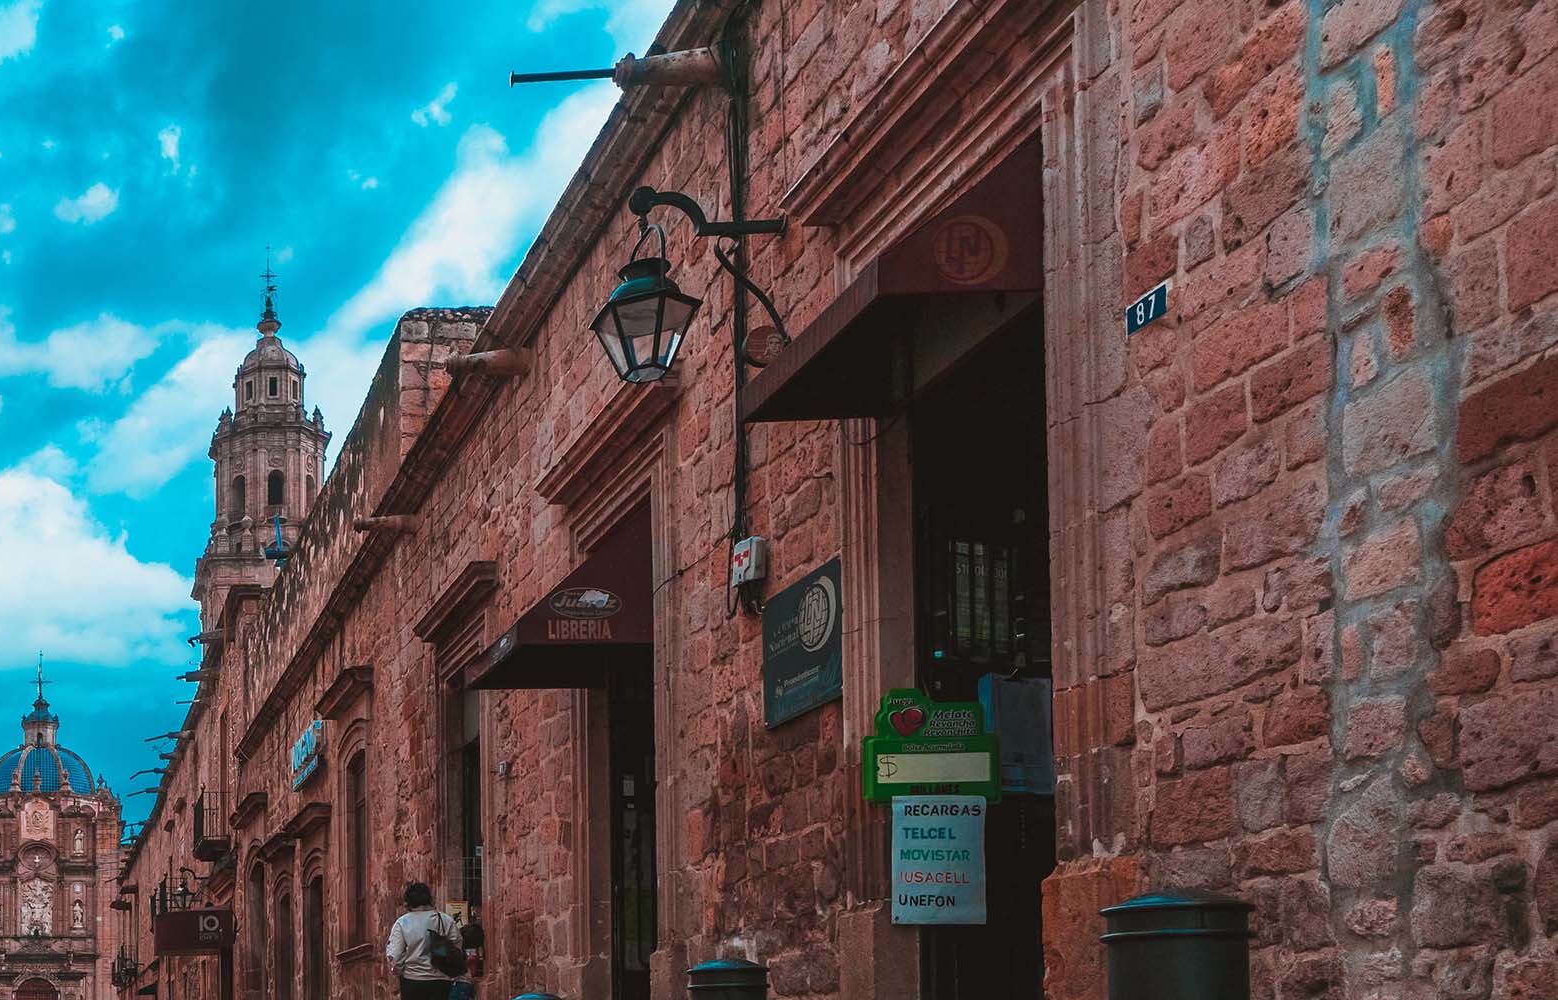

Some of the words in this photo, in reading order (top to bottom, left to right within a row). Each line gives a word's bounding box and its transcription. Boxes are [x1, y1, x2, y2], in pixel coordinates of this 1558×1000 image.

[1137, 293, 1156, 325] 87
[548, 619, 611, 640] LIBRERIA
[928, 719, 976, 729] Revancha
[923, 728, 978, 737] Revanchita
[904, 803, 982, 817] RECARGAS
[902, 827, 957, 840] TELCEL
[900, 848, 971, 862] MOVISTAR
[900, 871, 971, 884] IUSACELL
[898, 893, 956, 908] UNEFON
